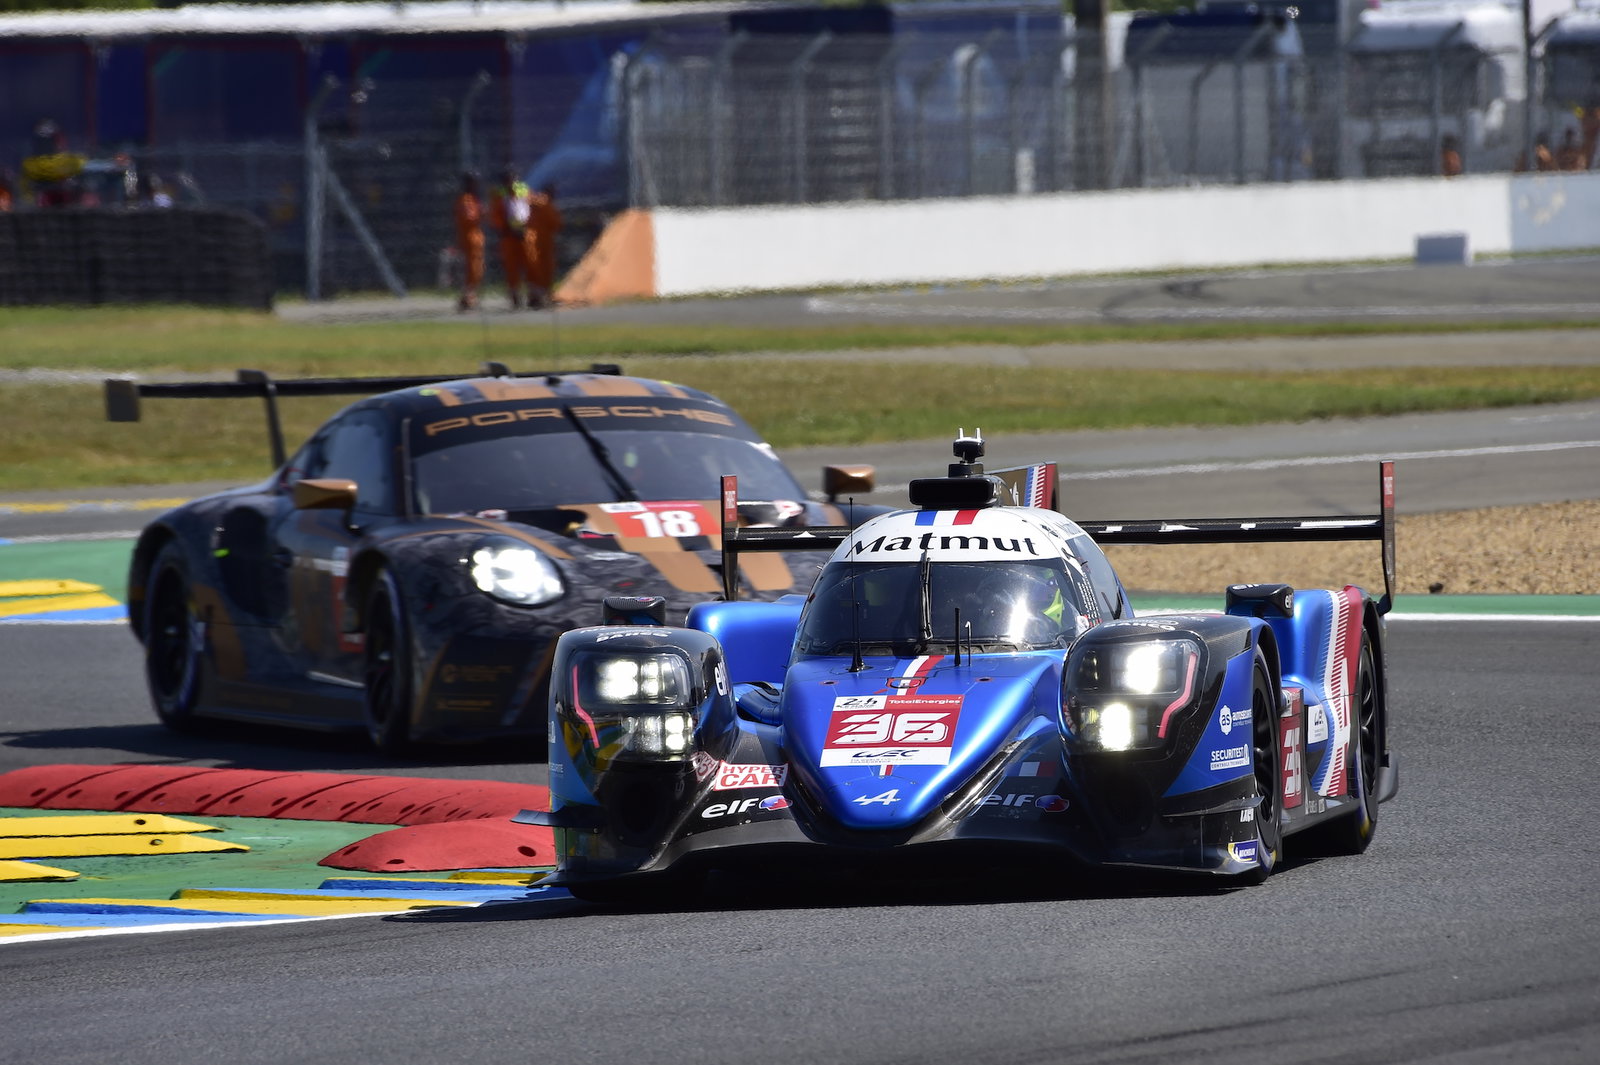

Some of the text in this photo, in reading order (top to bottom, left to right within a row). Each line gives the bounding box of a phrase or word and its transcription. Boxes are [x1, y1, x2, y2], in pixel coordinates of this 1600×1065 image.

[425, 406, 735, 437] PORSCHE
[629, 510, 701, 538] 18
[845, 532, 1040, 559] Matmut
[832, 713, 949, 745] 36
[720, 773, 784, 787] CAR
[723, 766, 785, 774] HYPER
[701, 798, 760, 818] elf
